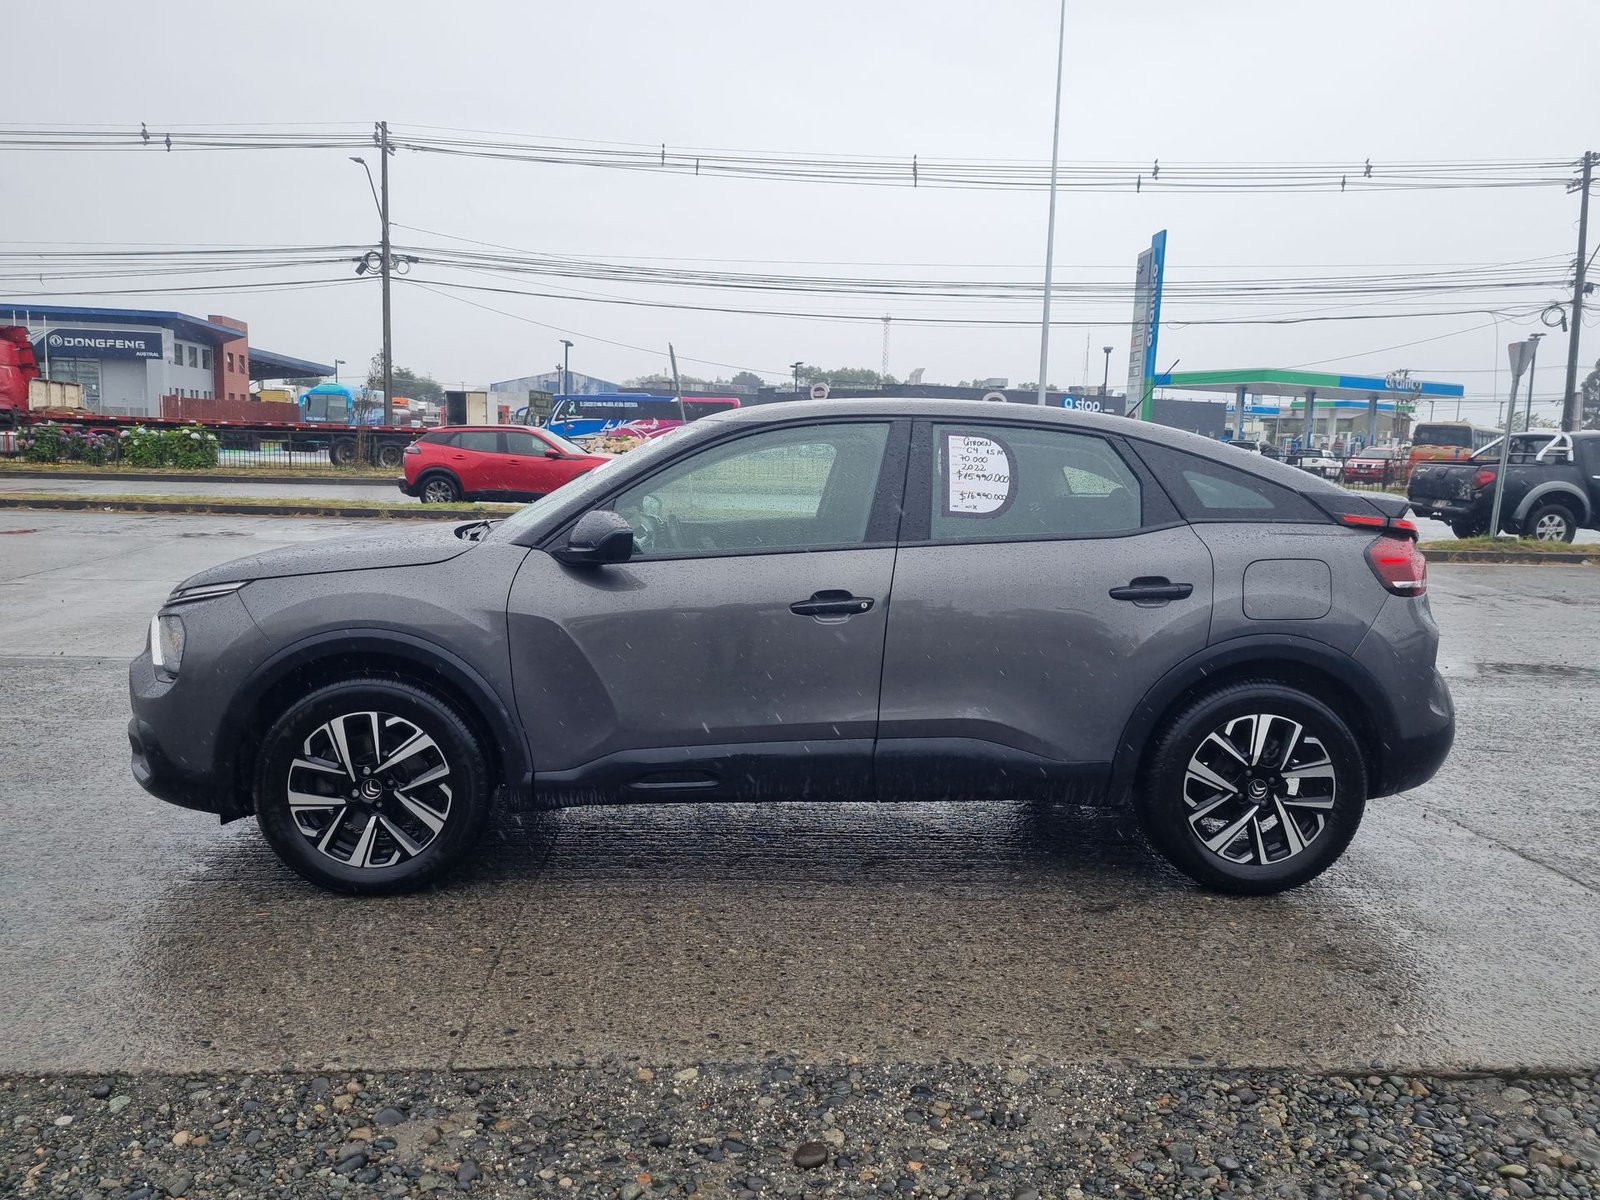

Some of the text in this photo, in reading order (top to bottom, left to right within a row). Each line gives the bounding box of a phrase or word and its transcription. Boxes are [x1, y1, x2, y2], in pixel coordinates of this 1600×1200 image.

[64, 337, 146, 350] DONGFENG
[960, 454, 988, 464] 70.000
[961, 463, 987, 472] 2022
[956, 469, 1009, 483] $15.990.000
